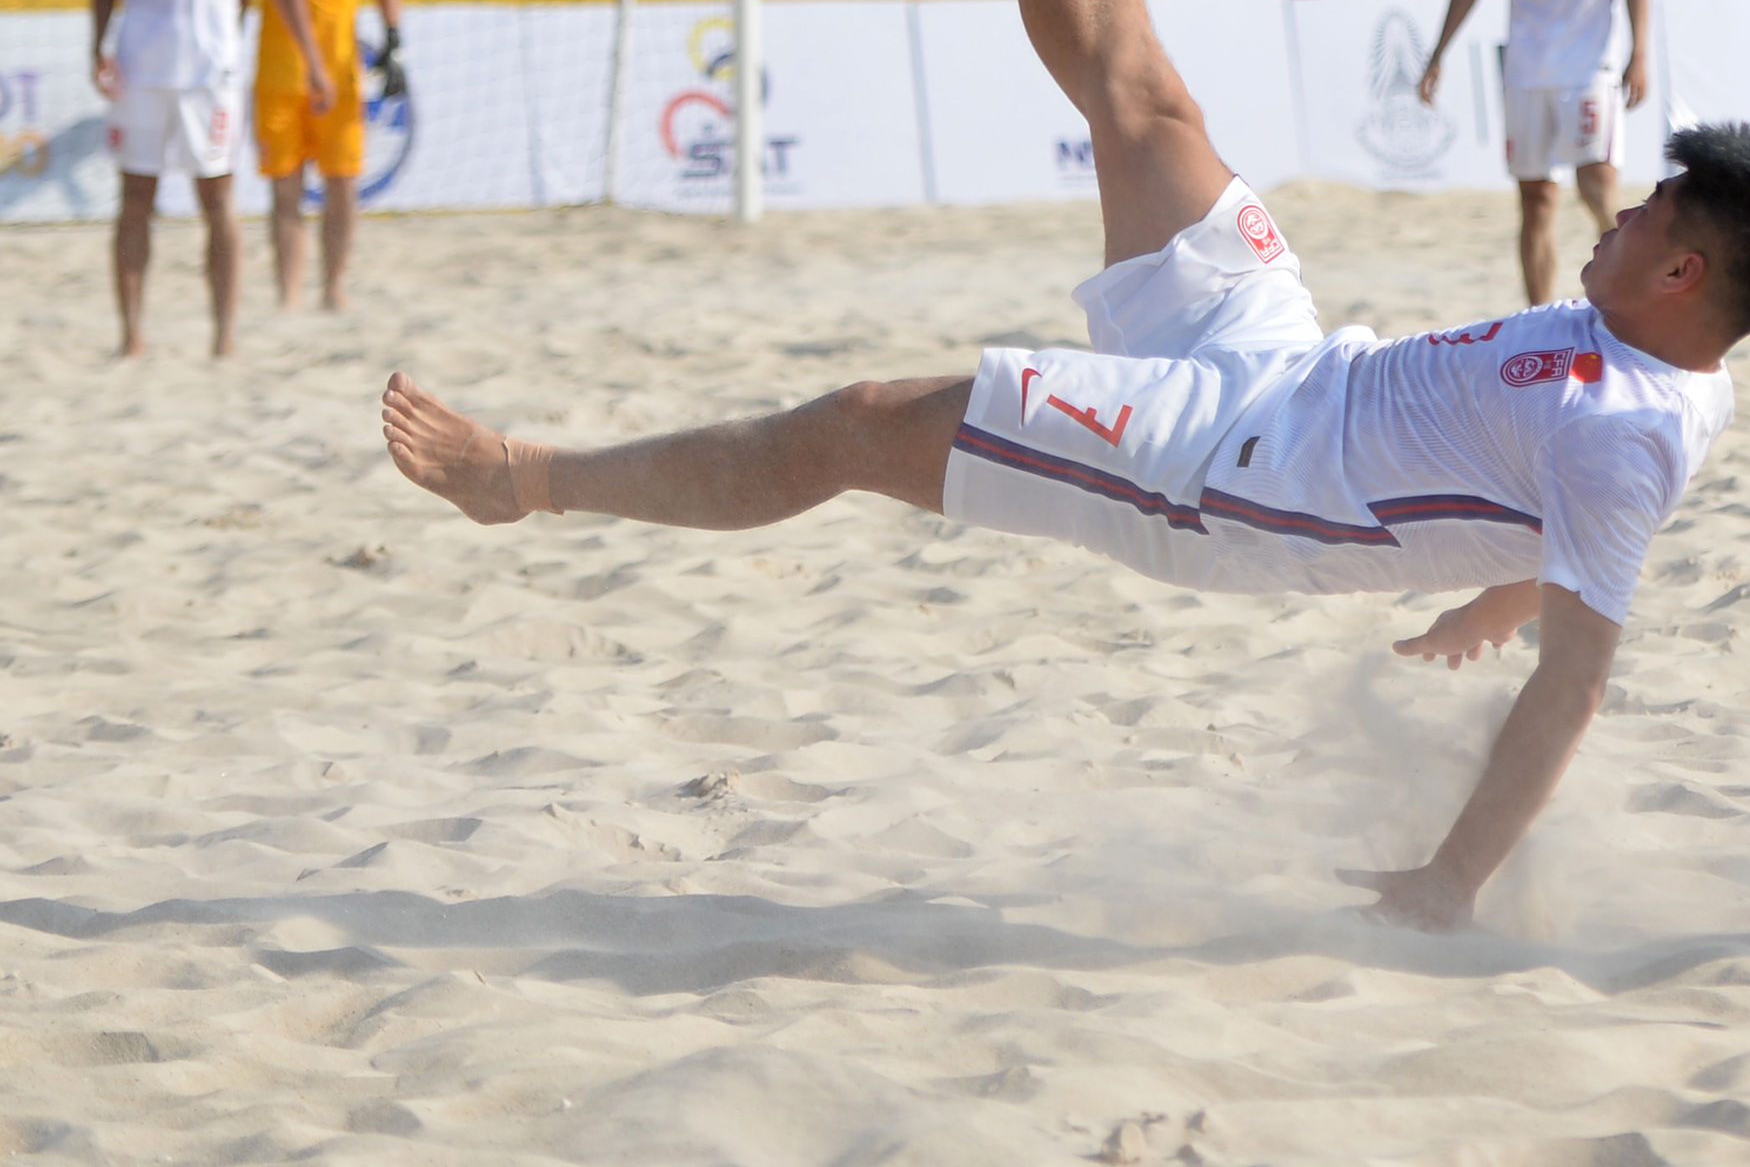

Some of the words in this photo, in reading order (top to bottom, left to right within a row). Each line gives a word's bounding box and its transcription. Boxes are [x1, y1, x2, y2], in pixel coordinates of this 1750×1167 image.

[1579, 99, 1598, 134] 5
[680, 136, 800, 178] ST
[1552, 352, 1567, 377] CFA
[1047, 393, 1134, 448] 7
